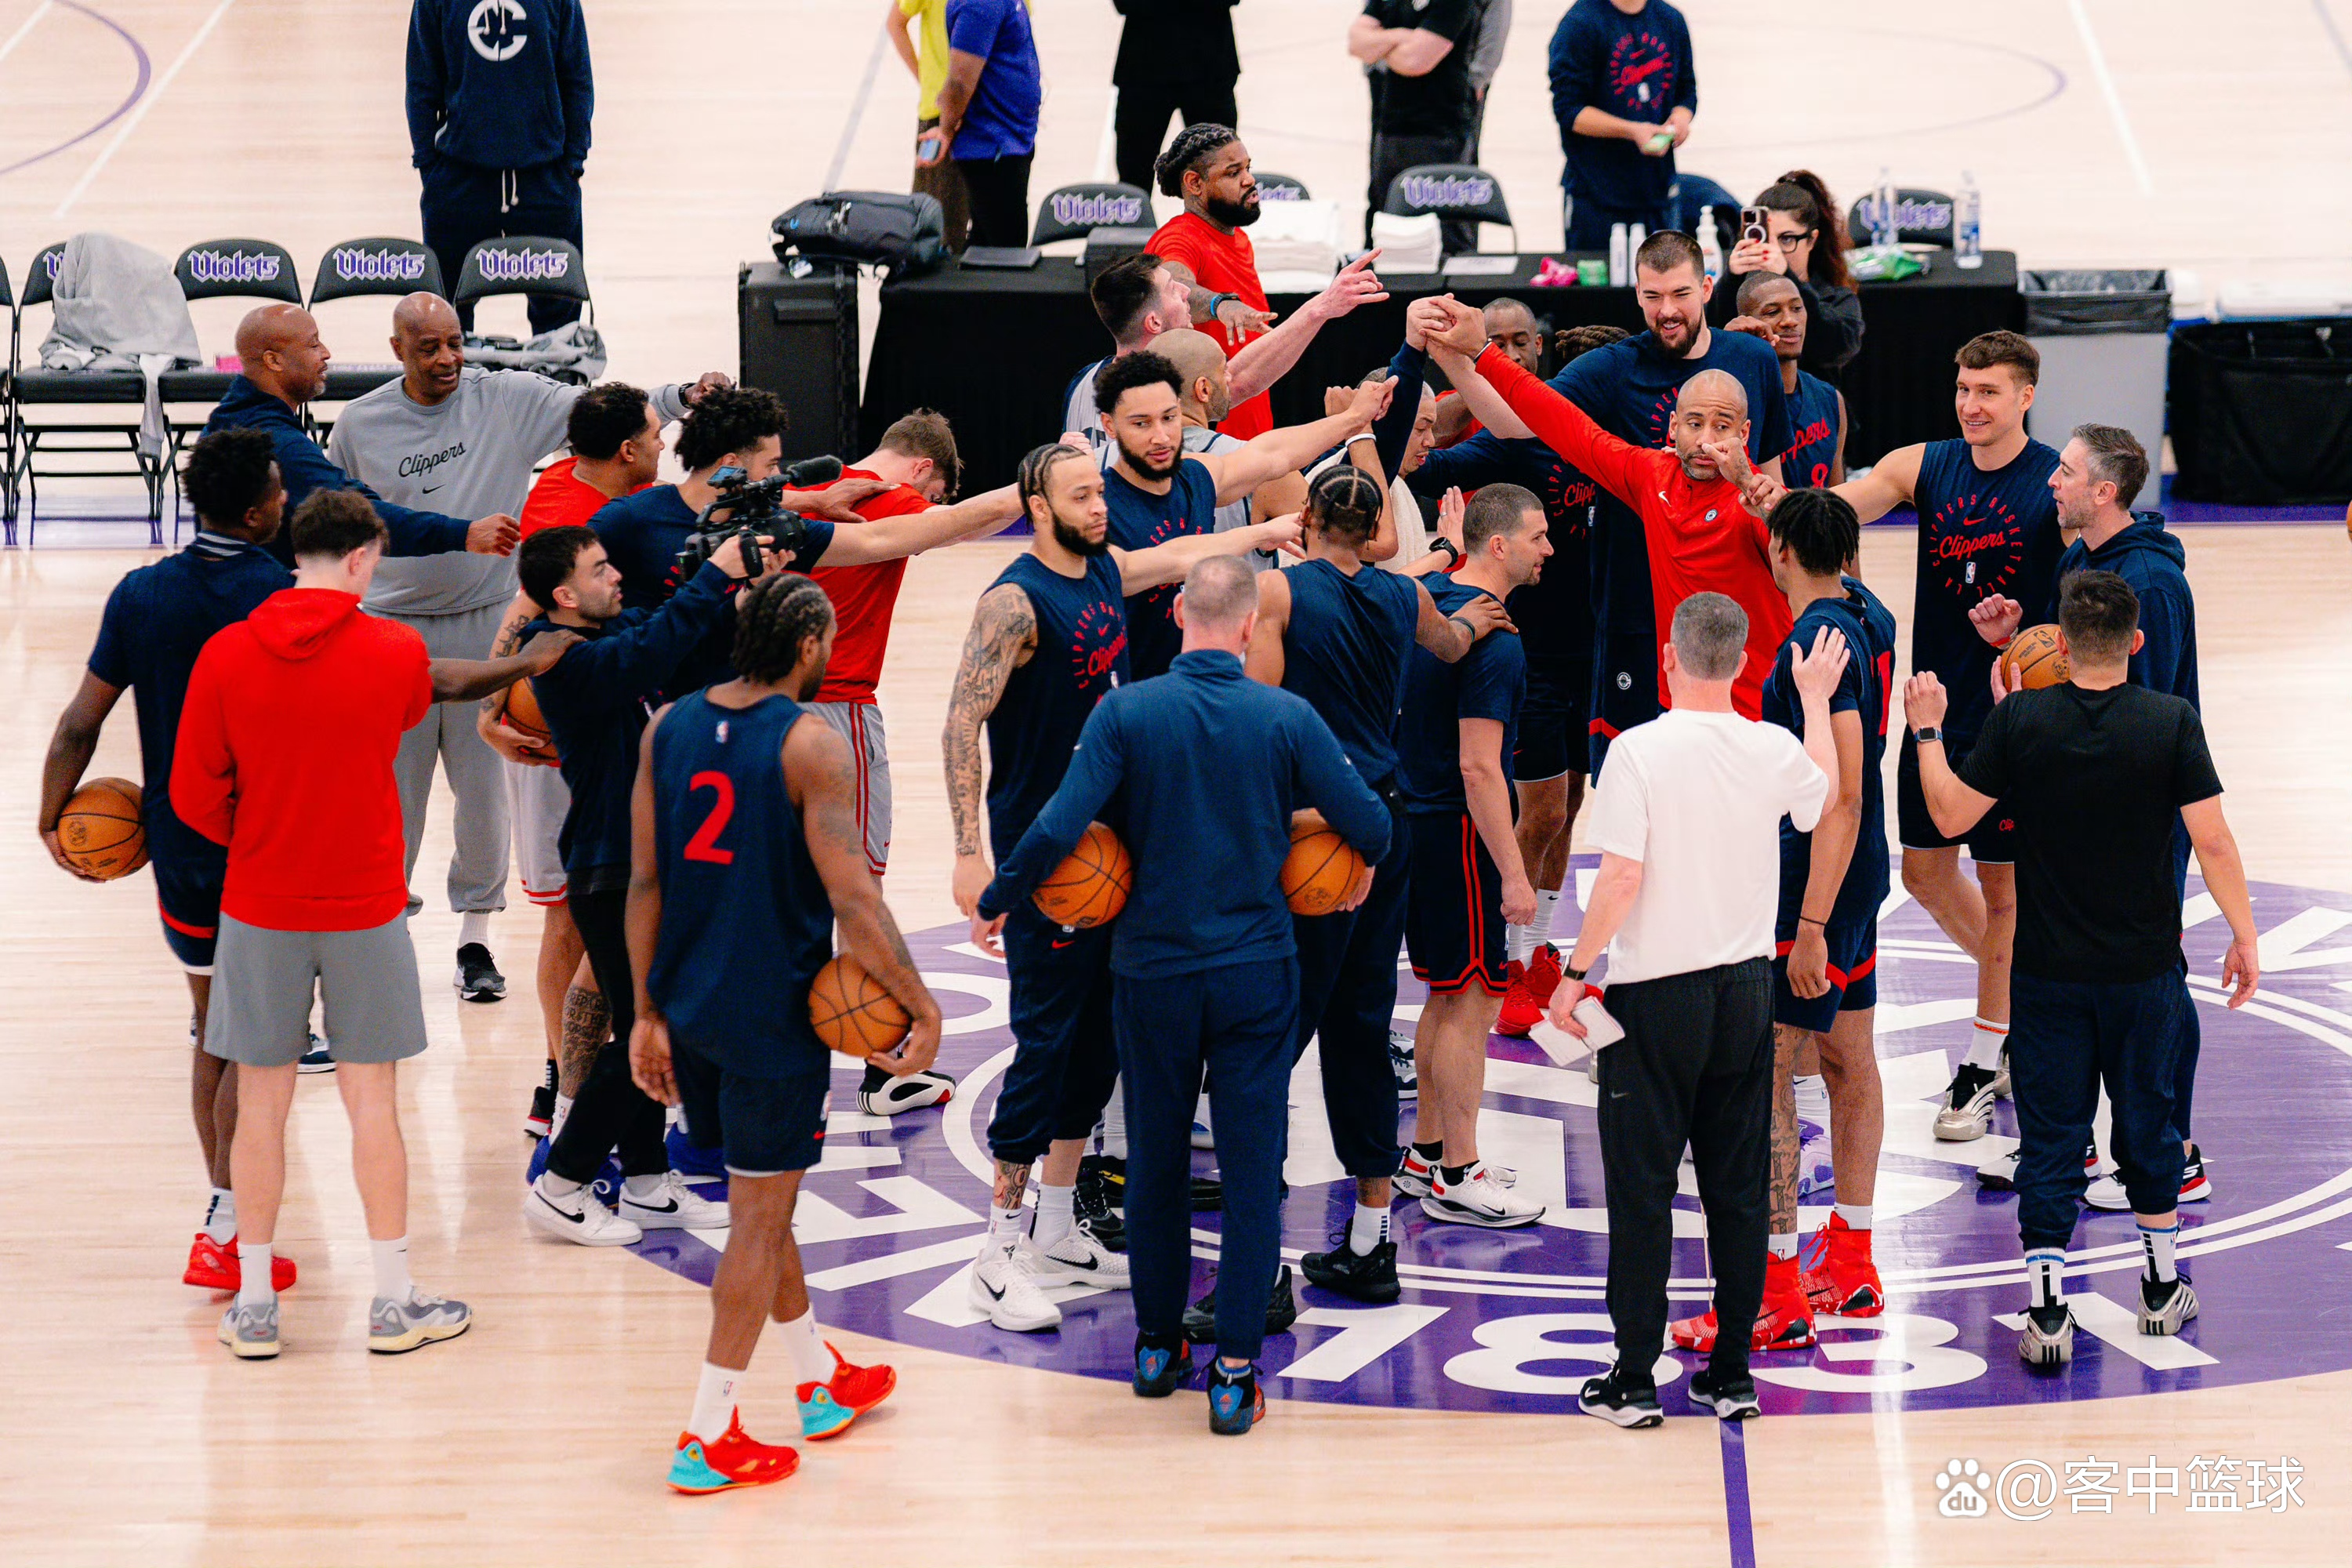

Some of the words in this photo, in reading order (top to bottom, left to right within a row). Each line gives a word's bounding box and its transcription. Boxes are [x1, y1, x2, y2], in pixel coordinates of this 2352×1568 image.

[187, 249, 281, 283] Violets
[332, 247, 426, 281] Violets
[474, 247, 568, 281] Violets
[398, 441, 466, 477] Clippers
[1940, 531, 2006, 561] Clippers
[684, 770, 735, 866] 2
